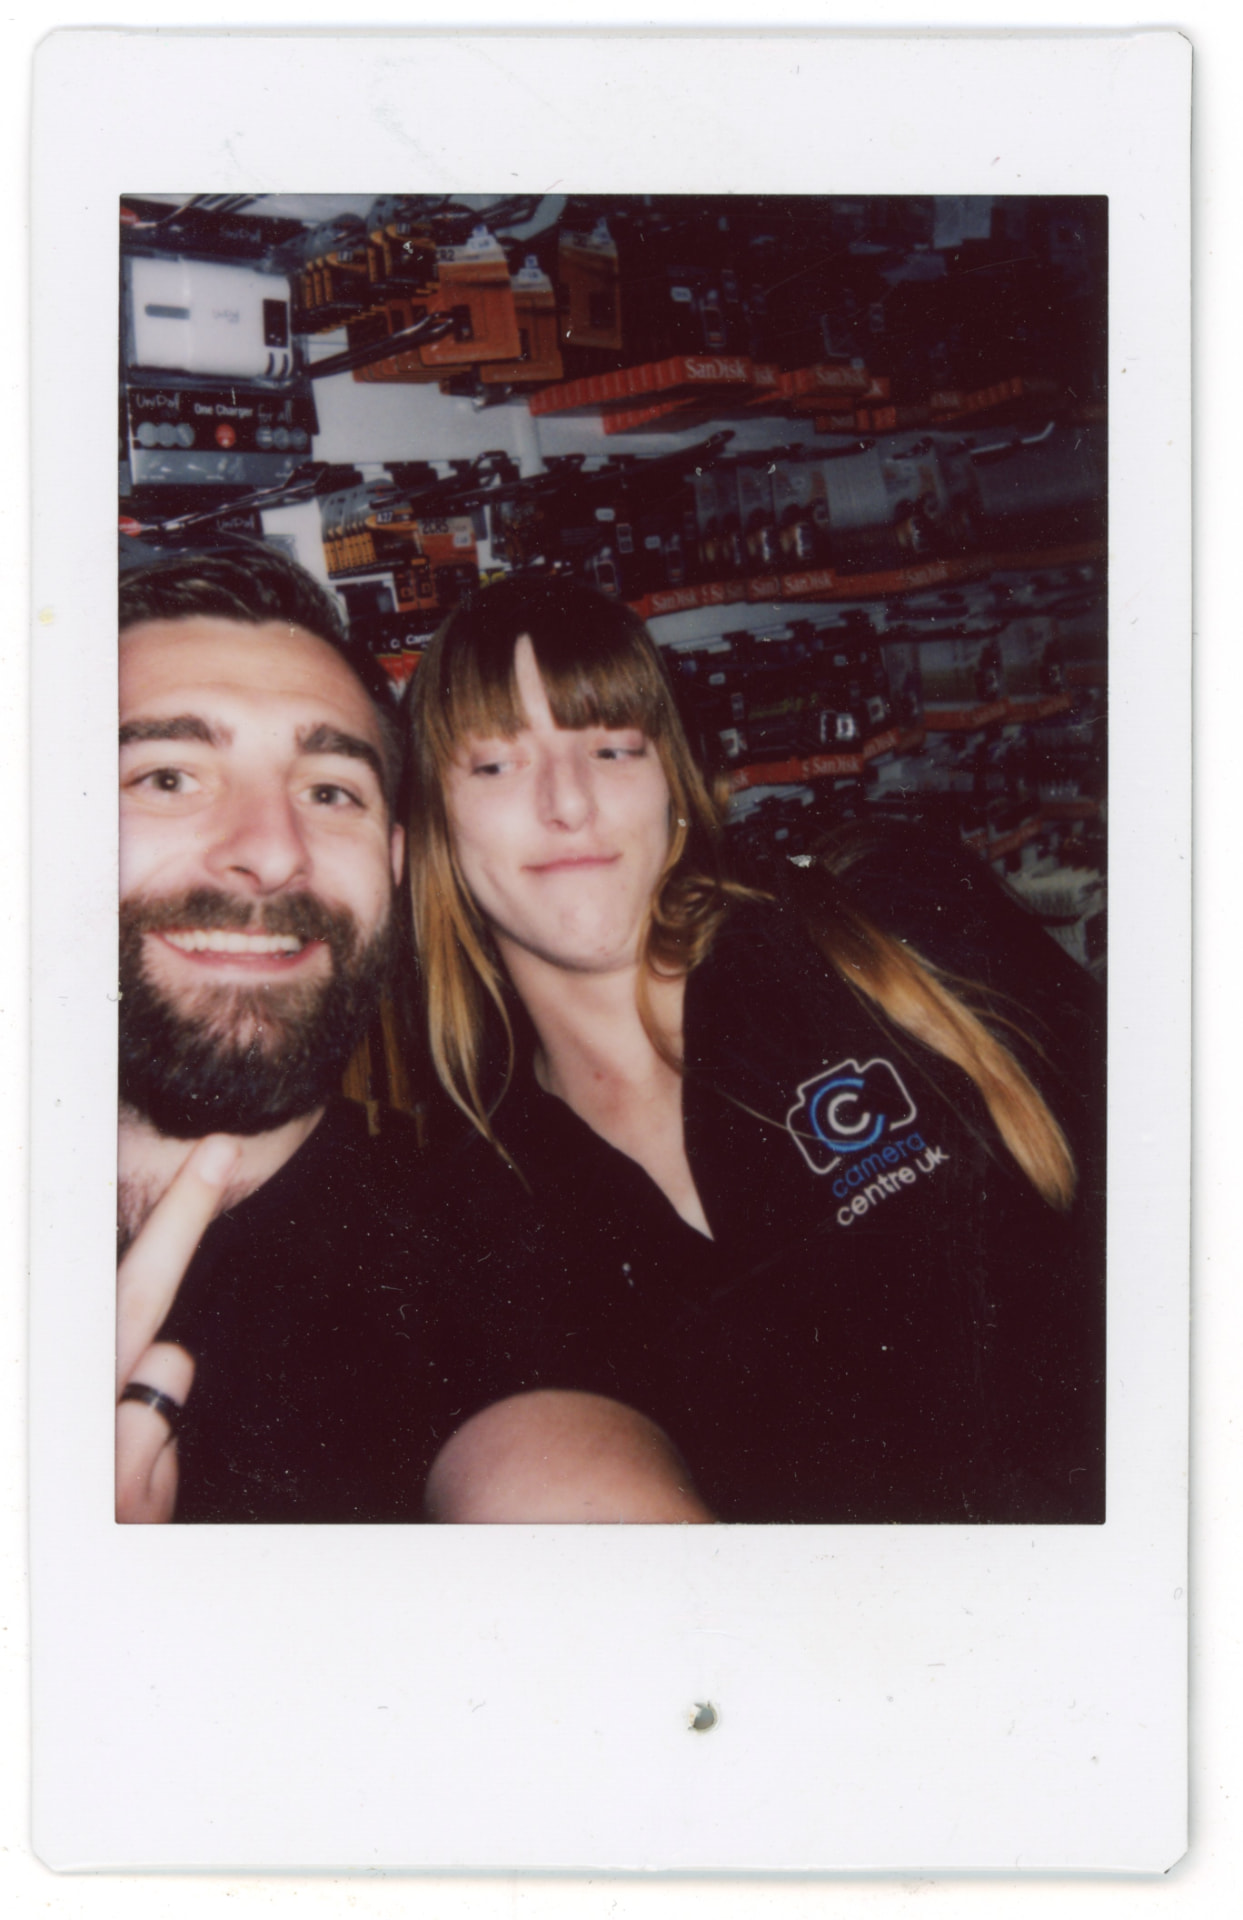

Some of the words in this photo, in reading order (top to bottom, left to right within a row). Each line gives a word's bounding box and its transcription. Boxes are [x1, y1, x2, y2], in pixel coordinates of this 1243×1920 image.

[684, 358, 748, 379] SanDisk
[136, 392, 181, 410] UniPal
[193, 402, 214, 416] One
[215, 404, 254, 419] Charger
[783, 571, 834, 594] SanDisk
[651, 590, 698, 610] SanDisk
[812, 754, 860, 774] SanDisk
[832, 1130, 928, 1199] camera
[836, 1165, 918, 1227] centre
[914, 1145, 951, 1174] uk
